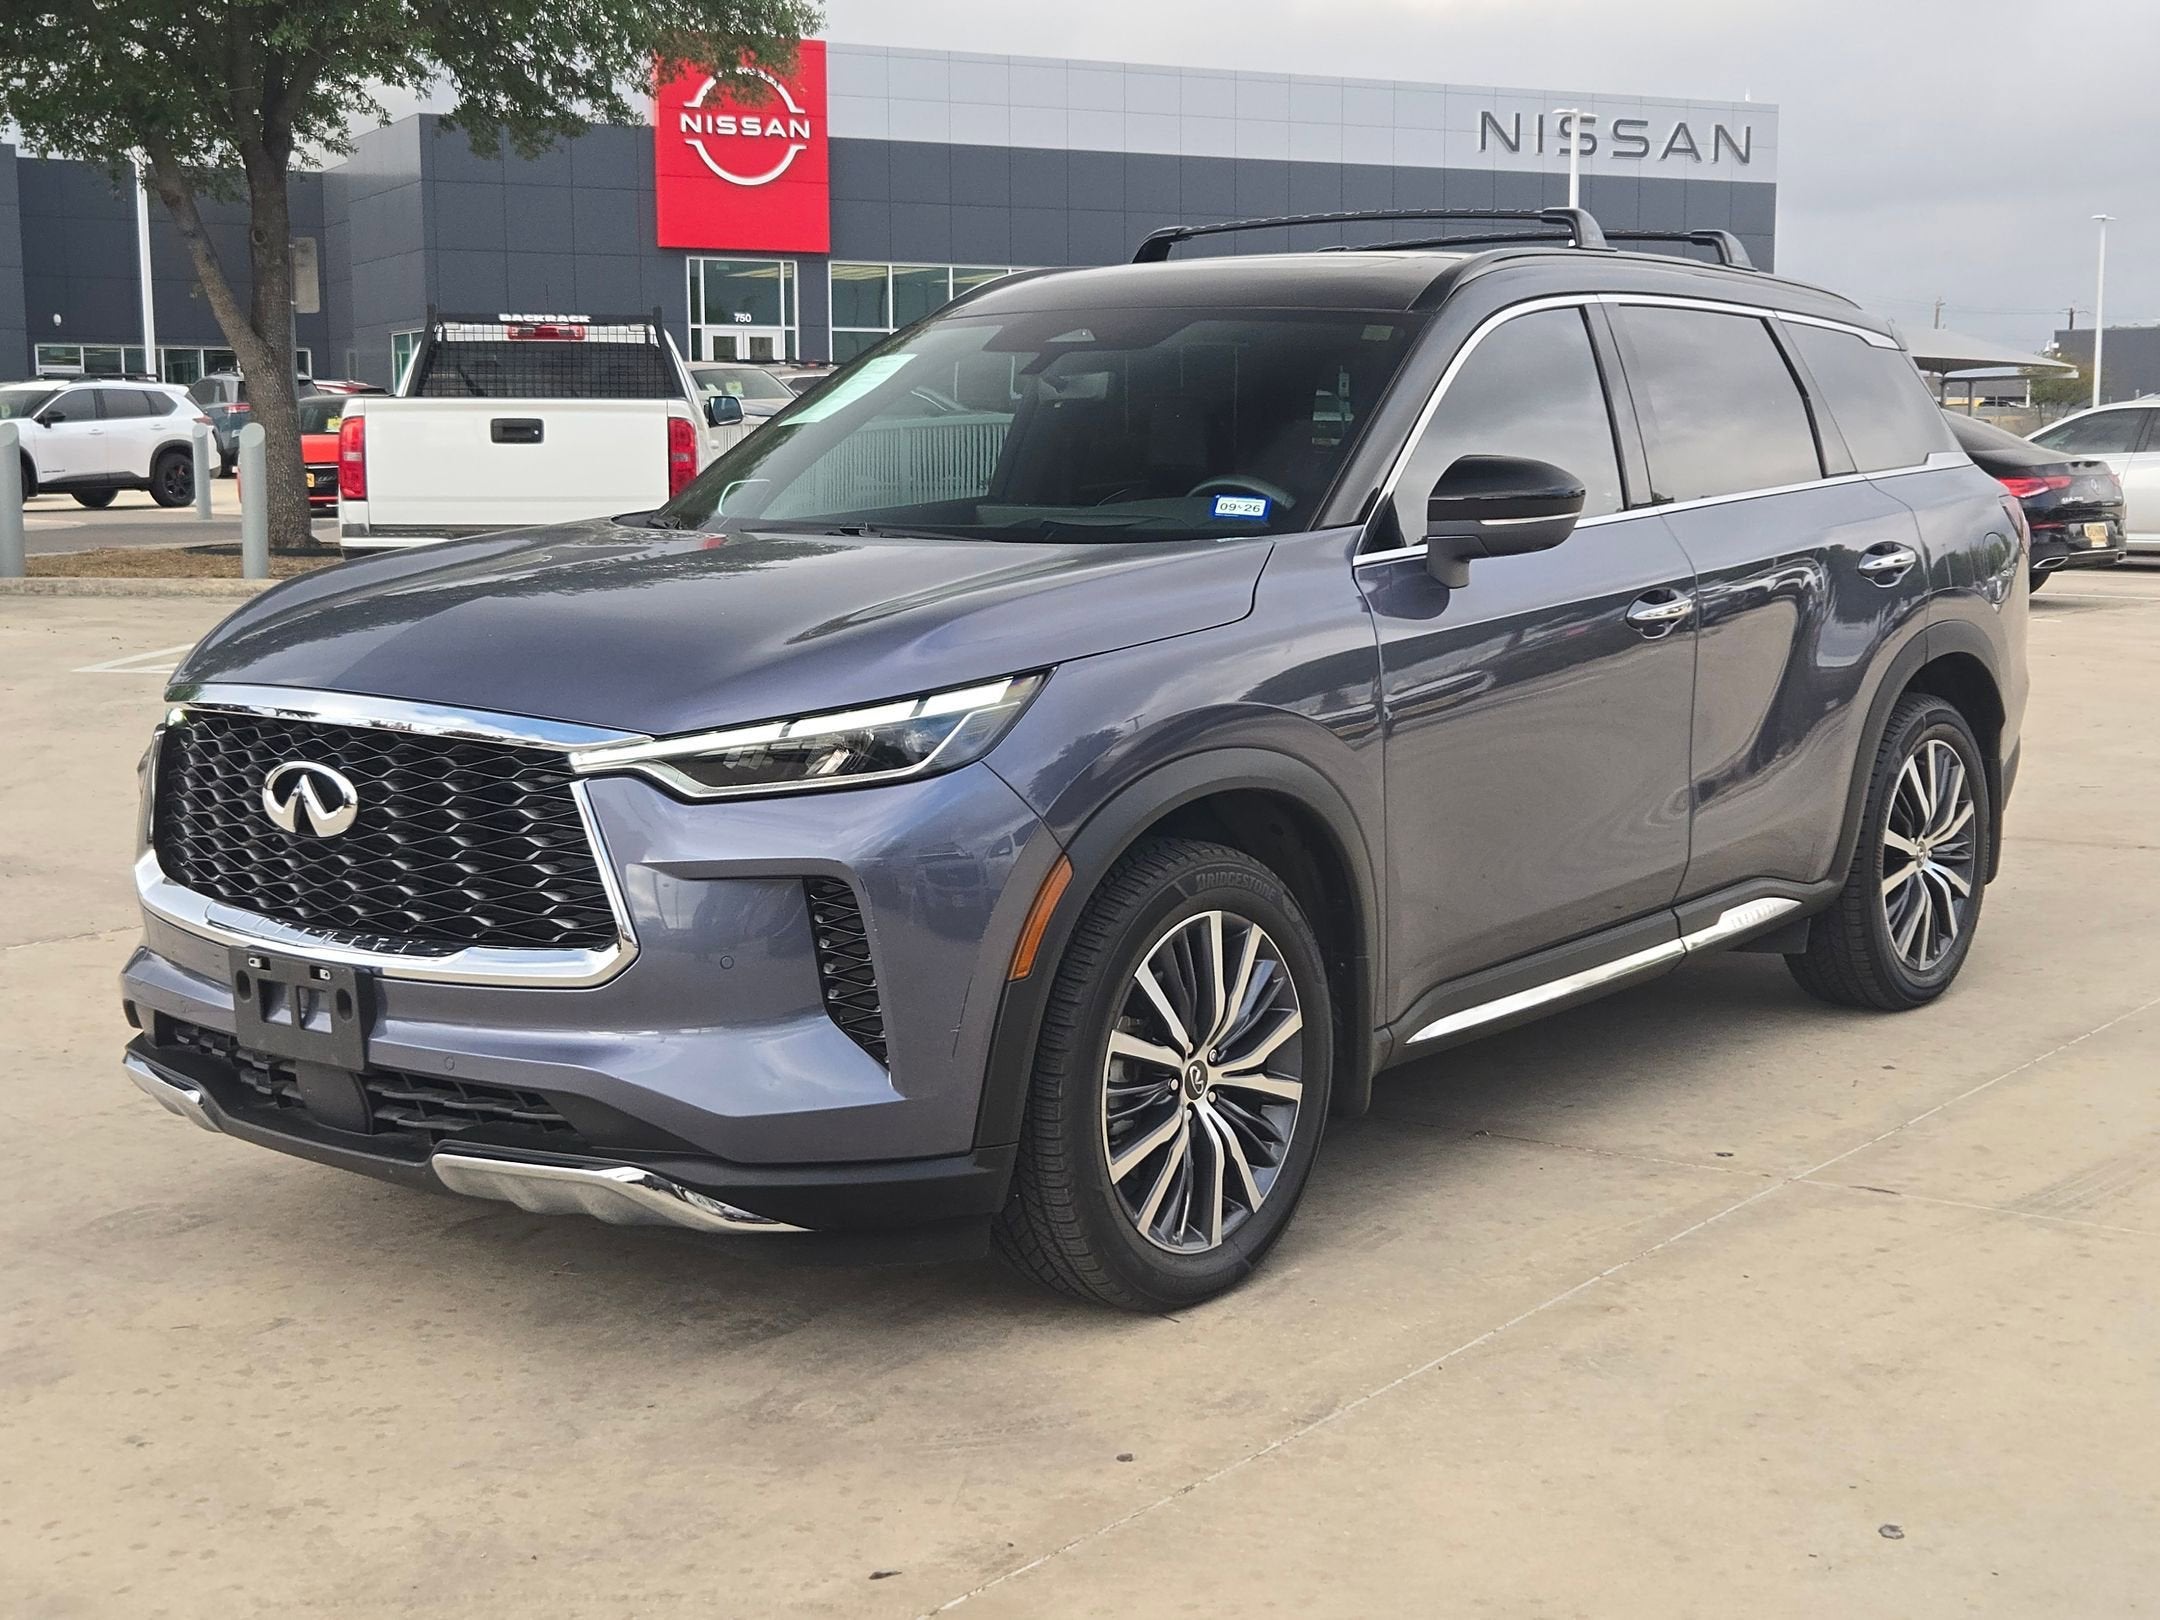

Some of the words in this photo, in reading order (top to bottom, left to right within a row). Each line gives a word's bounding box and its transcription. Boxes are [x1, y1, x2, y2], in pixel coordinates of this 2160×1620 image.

[680, 112, 811, 139] NISSAN
[1479, 110, 1752, 165] NISSAN
[498, 313, 592, 323] BACKRACK
[734, 312, 752, 323] 750
